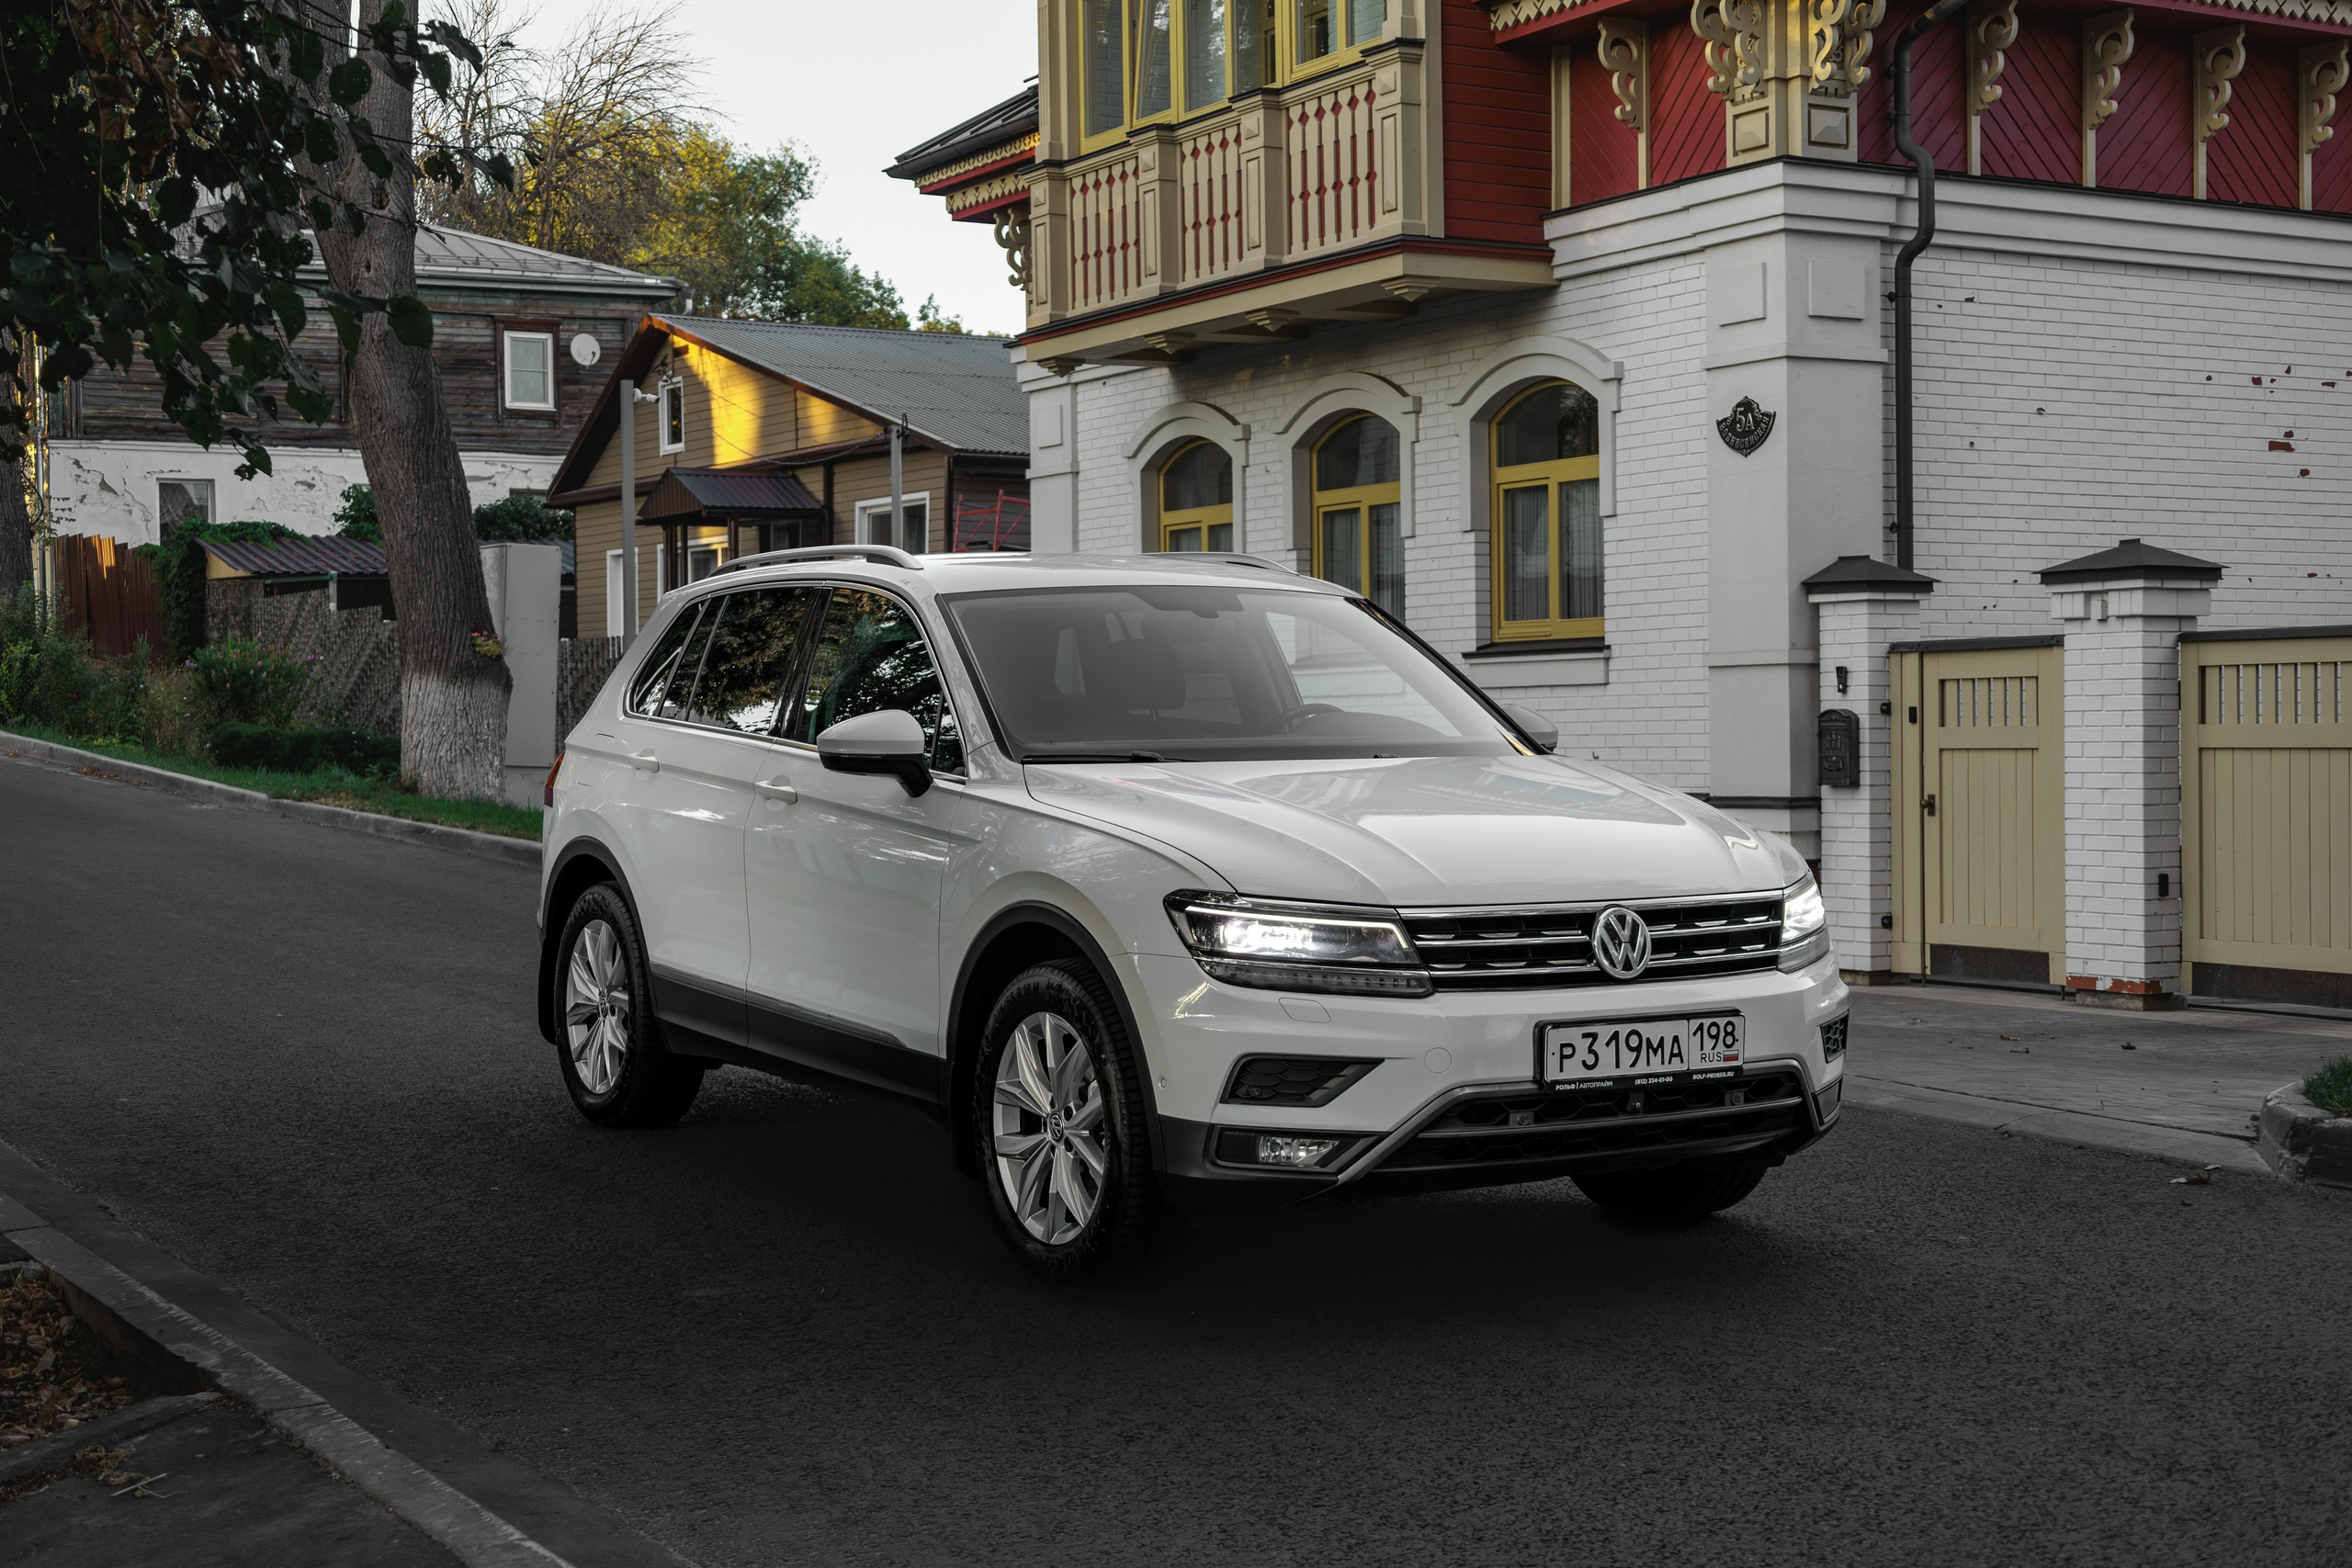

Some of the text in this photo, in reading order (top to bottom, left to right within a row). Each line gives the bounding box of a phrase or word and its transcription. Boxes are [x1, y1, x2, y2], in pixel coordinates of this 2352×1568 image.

[1736, 407, 1755, 432] 5А
[1719, 415, 1770, 449] ВОЗНЕСЕНСКАЯ
[1691, 1020, 1736, 1052] 198
[1700, 1051, 1723, 1063] RUS
[1648, 1076, 1673, 1084] 334-01-00
[1692, 1071, 1735, 1080] ROLF-PROBEG.RU
[1579, 1080, 1612, 1089] АВТОПРАЙМ
